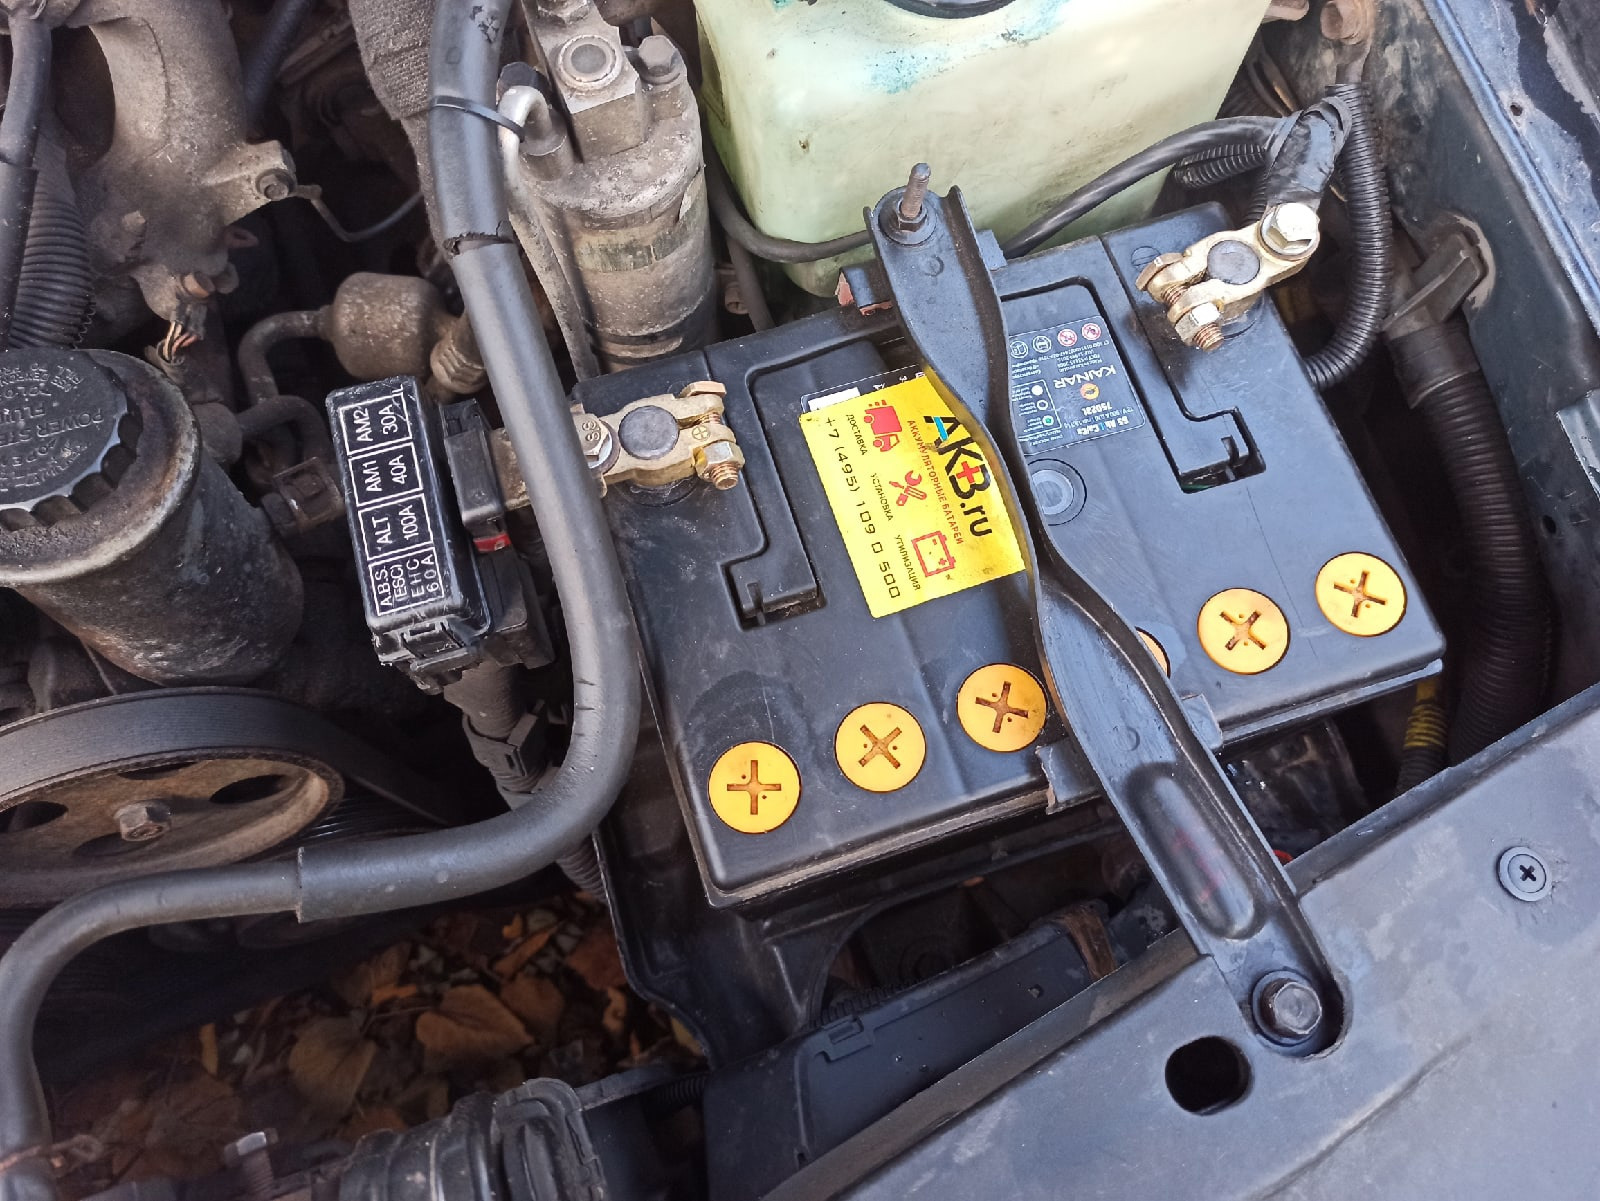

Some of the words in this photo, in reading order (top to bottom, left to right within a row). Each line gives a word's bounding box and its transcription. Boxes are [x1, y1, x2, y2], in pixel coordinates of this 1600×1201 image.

[1053, 364, 1117, 389] KAINAR
[36, 410, 105, 438] POWER
[353, 407, 374, 442] AM2
[378, 404, 398, 435] 30A
[845, 414, 868, 456] ДОСТАВКА
[362, 460, 383, 492] AM1
[388, 454, 408, 485] 40A
[907, 420, 947, 502] АККУМУЛЯТОРНЫЕ
[941, 502, 965, 545] БАТАРЕИ
[826, 417, 840, 439] +7
[834, 446, 860, 492] (495)
[856, 500, 876, 534] 109
[871, 541, 884, 554] 0
[879, 561, 901, 598] 500
[870, 472, 894, 521] УСТАНОВКА
[371, 516, 393, 544] ALT
[398, 504, 419, 540] 100A
[894, 534, 921, 591] УТИЛИЗАЦИЯ
[390, 564, 408, 602] (ESC)
